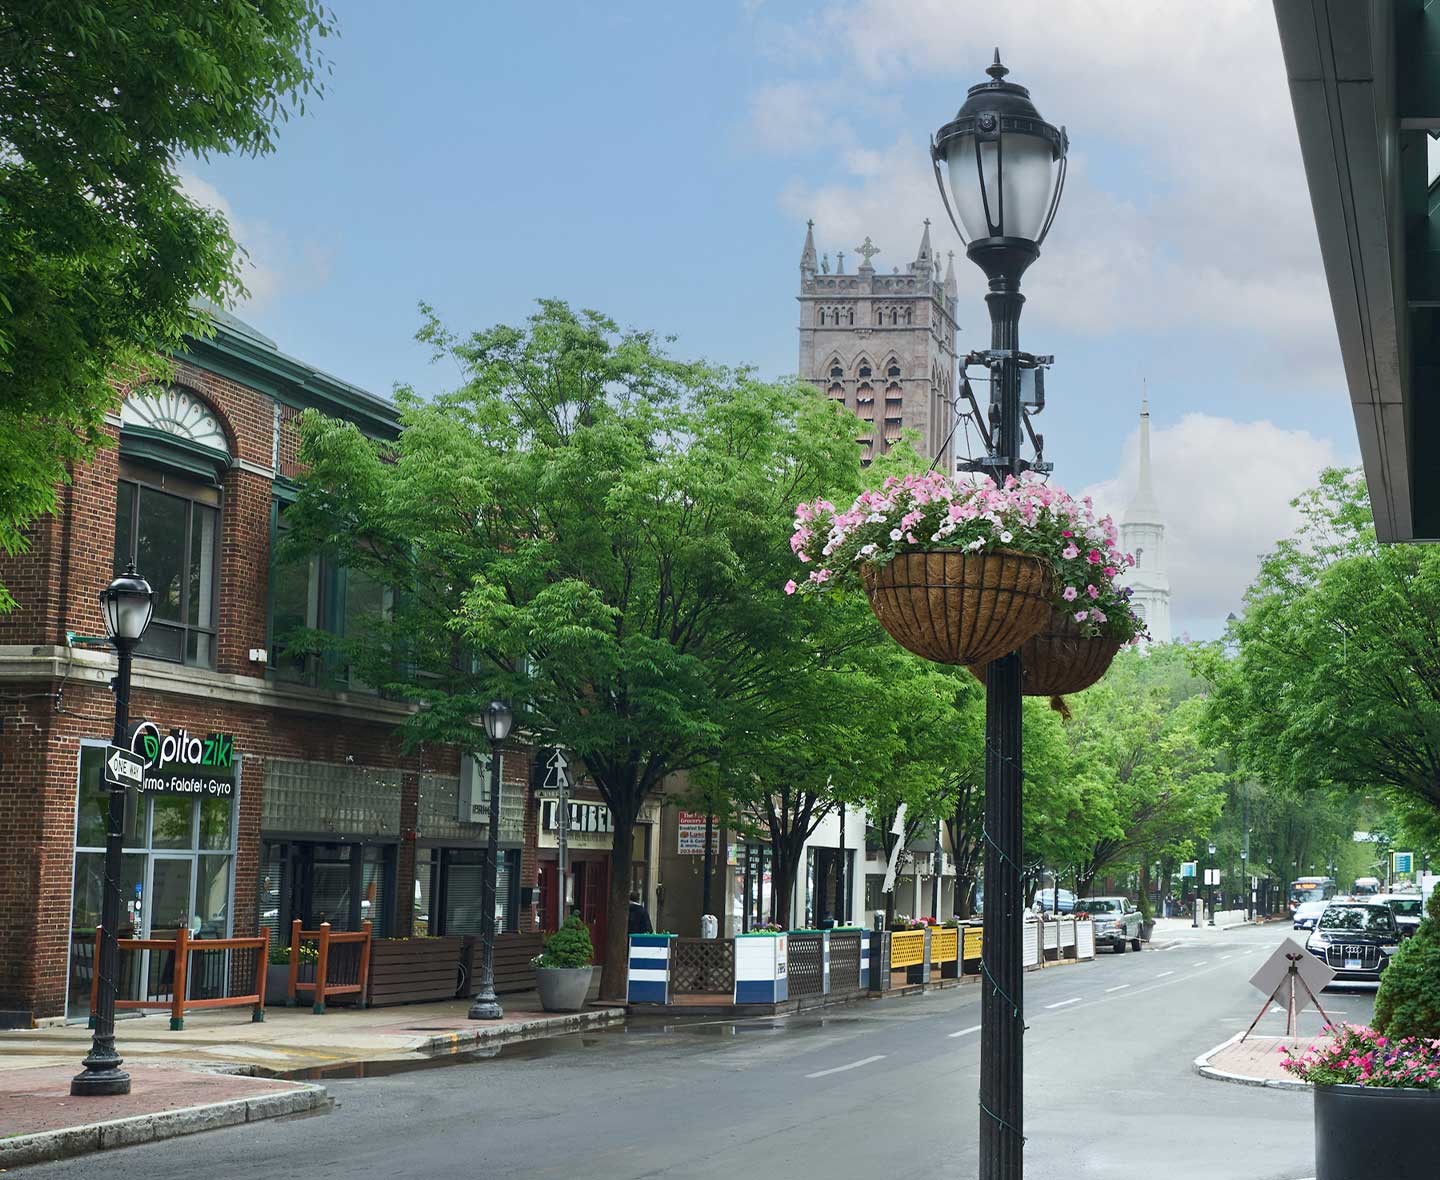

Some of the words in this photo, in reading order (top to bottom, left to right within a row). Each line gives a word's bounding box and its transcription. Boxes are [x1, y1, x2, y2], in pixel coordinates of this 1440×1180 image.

[159, 729, 235, 769] pitaziki
[113, 758, 127, 774] ONE
[129, 765, 140, 779] WAY
[144, 777, 164, 790] rma
[171, 777, 203, 793] Falafel
[208, 779, 231, 797] Gyro
[549, 801, 615, 833] LLIBEL
